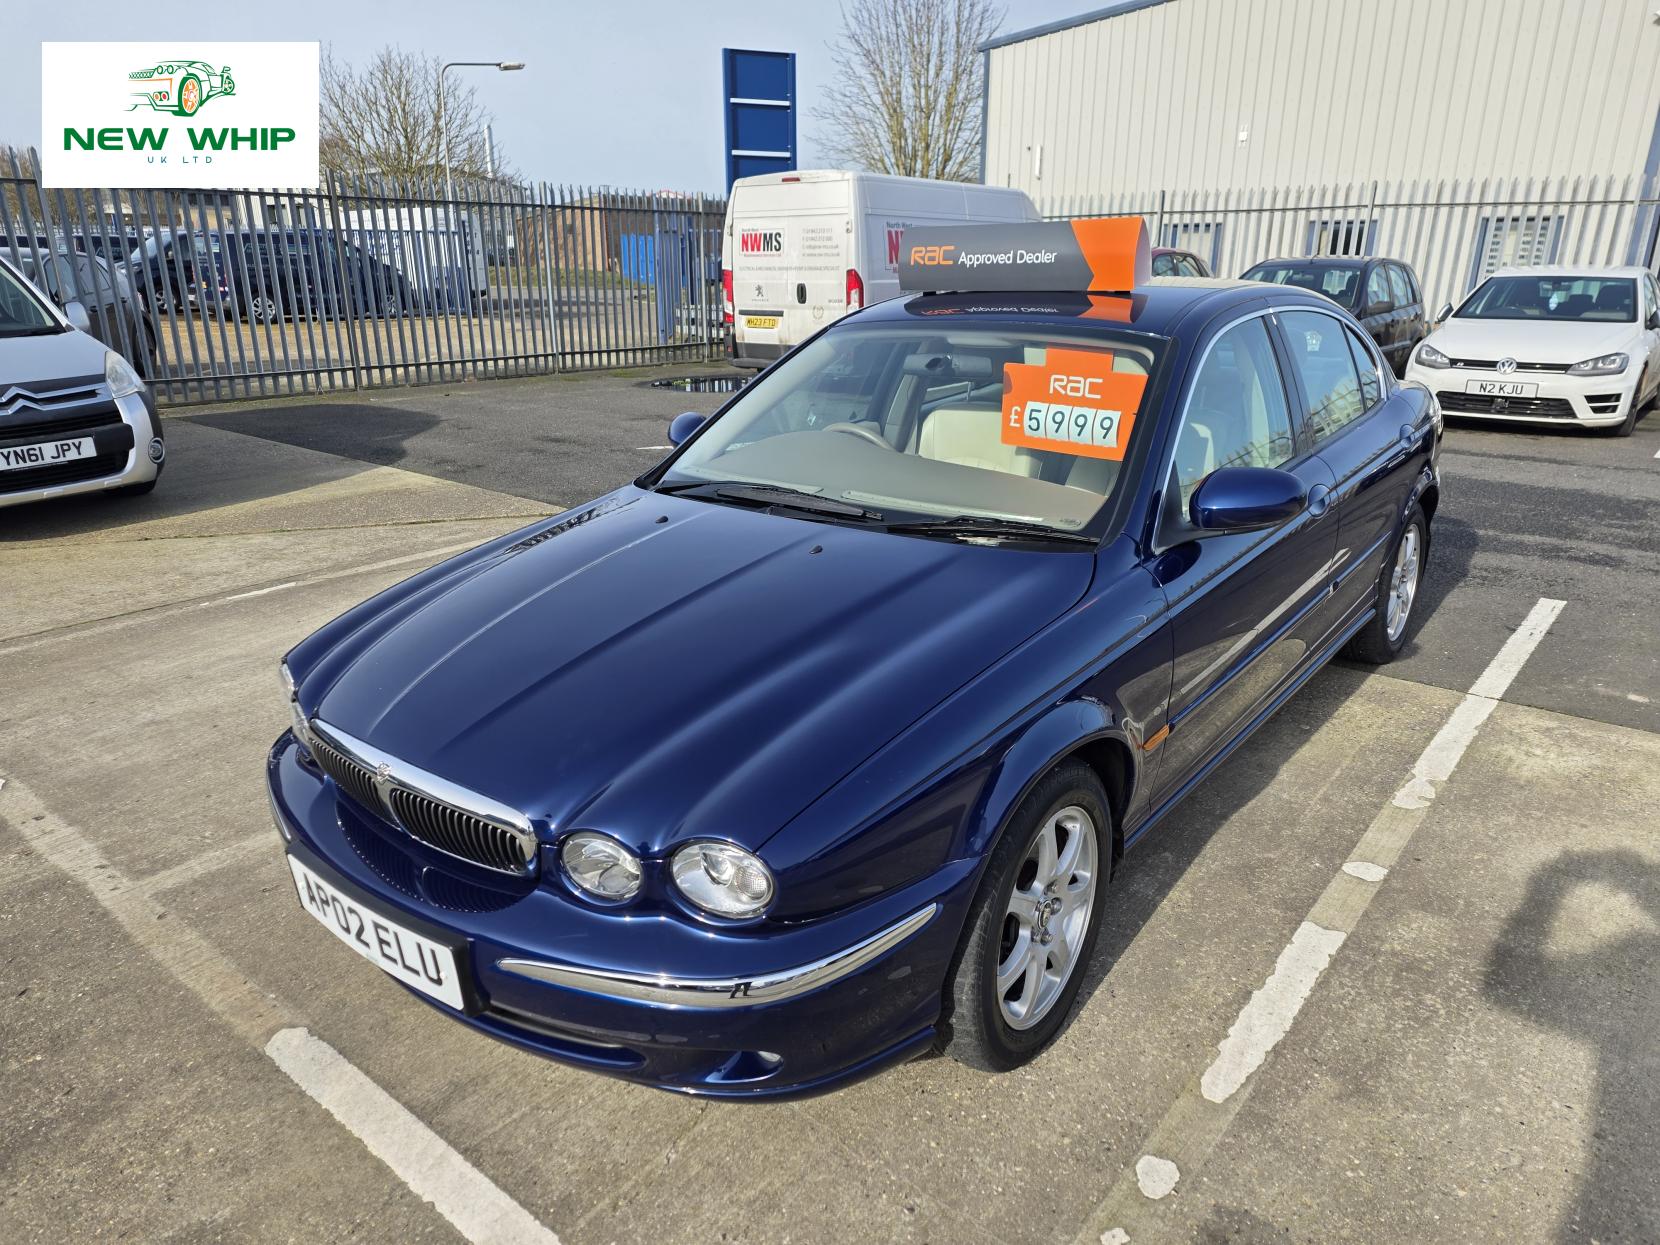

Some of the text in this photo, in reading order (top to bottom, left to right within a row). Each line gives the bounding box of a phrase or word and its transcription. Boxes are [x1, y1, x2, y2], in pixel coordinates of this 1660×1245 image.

[741, 232, 782, 252] NWMS
[957, 249, 1014, 268] Approved
[1016, 249, 1058, 264] Dealer
[1479, 382, 1524, 395] N2 KJU
[0, 440, 82, 466] YN61 JPY
[303, 871, 443, 987] AP02 ELU
